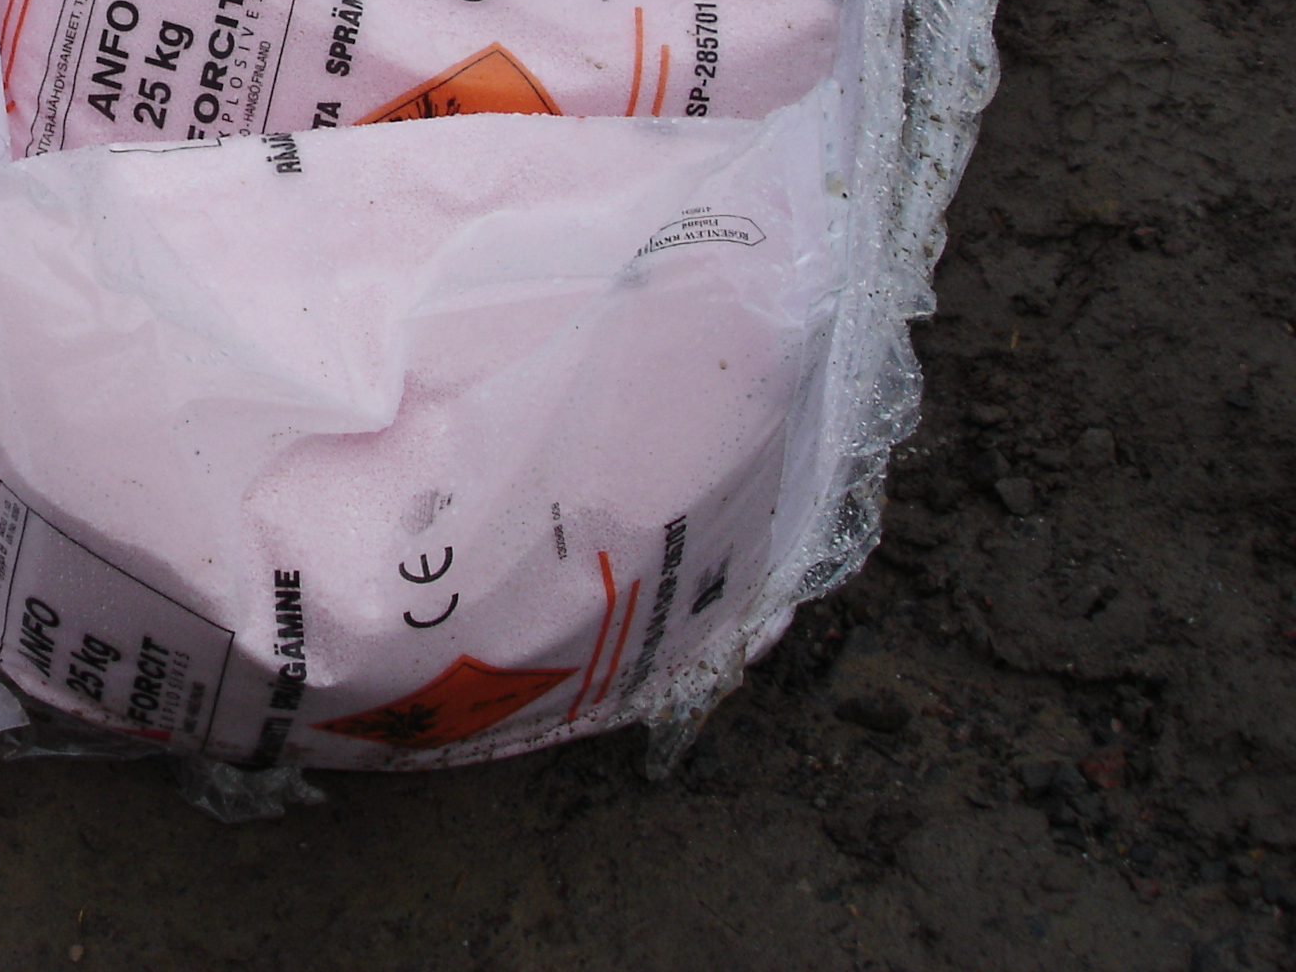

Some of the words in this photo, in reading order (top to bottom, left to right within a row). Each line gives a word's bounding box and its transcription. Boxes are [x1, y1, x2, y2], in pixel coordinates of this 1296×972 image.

[87, 0, 139, 121] ANFO
[144, 20, 193, 71] kg
[686, 3, 718, 116] SP-285701
[134, 78, 171, 129] 25
[681, 219, 718, 230] Finland
[70, 634, 121, 667] kg
[65, 665, 106, 701] 25
[129, 636, 169, 725] FORCIT
